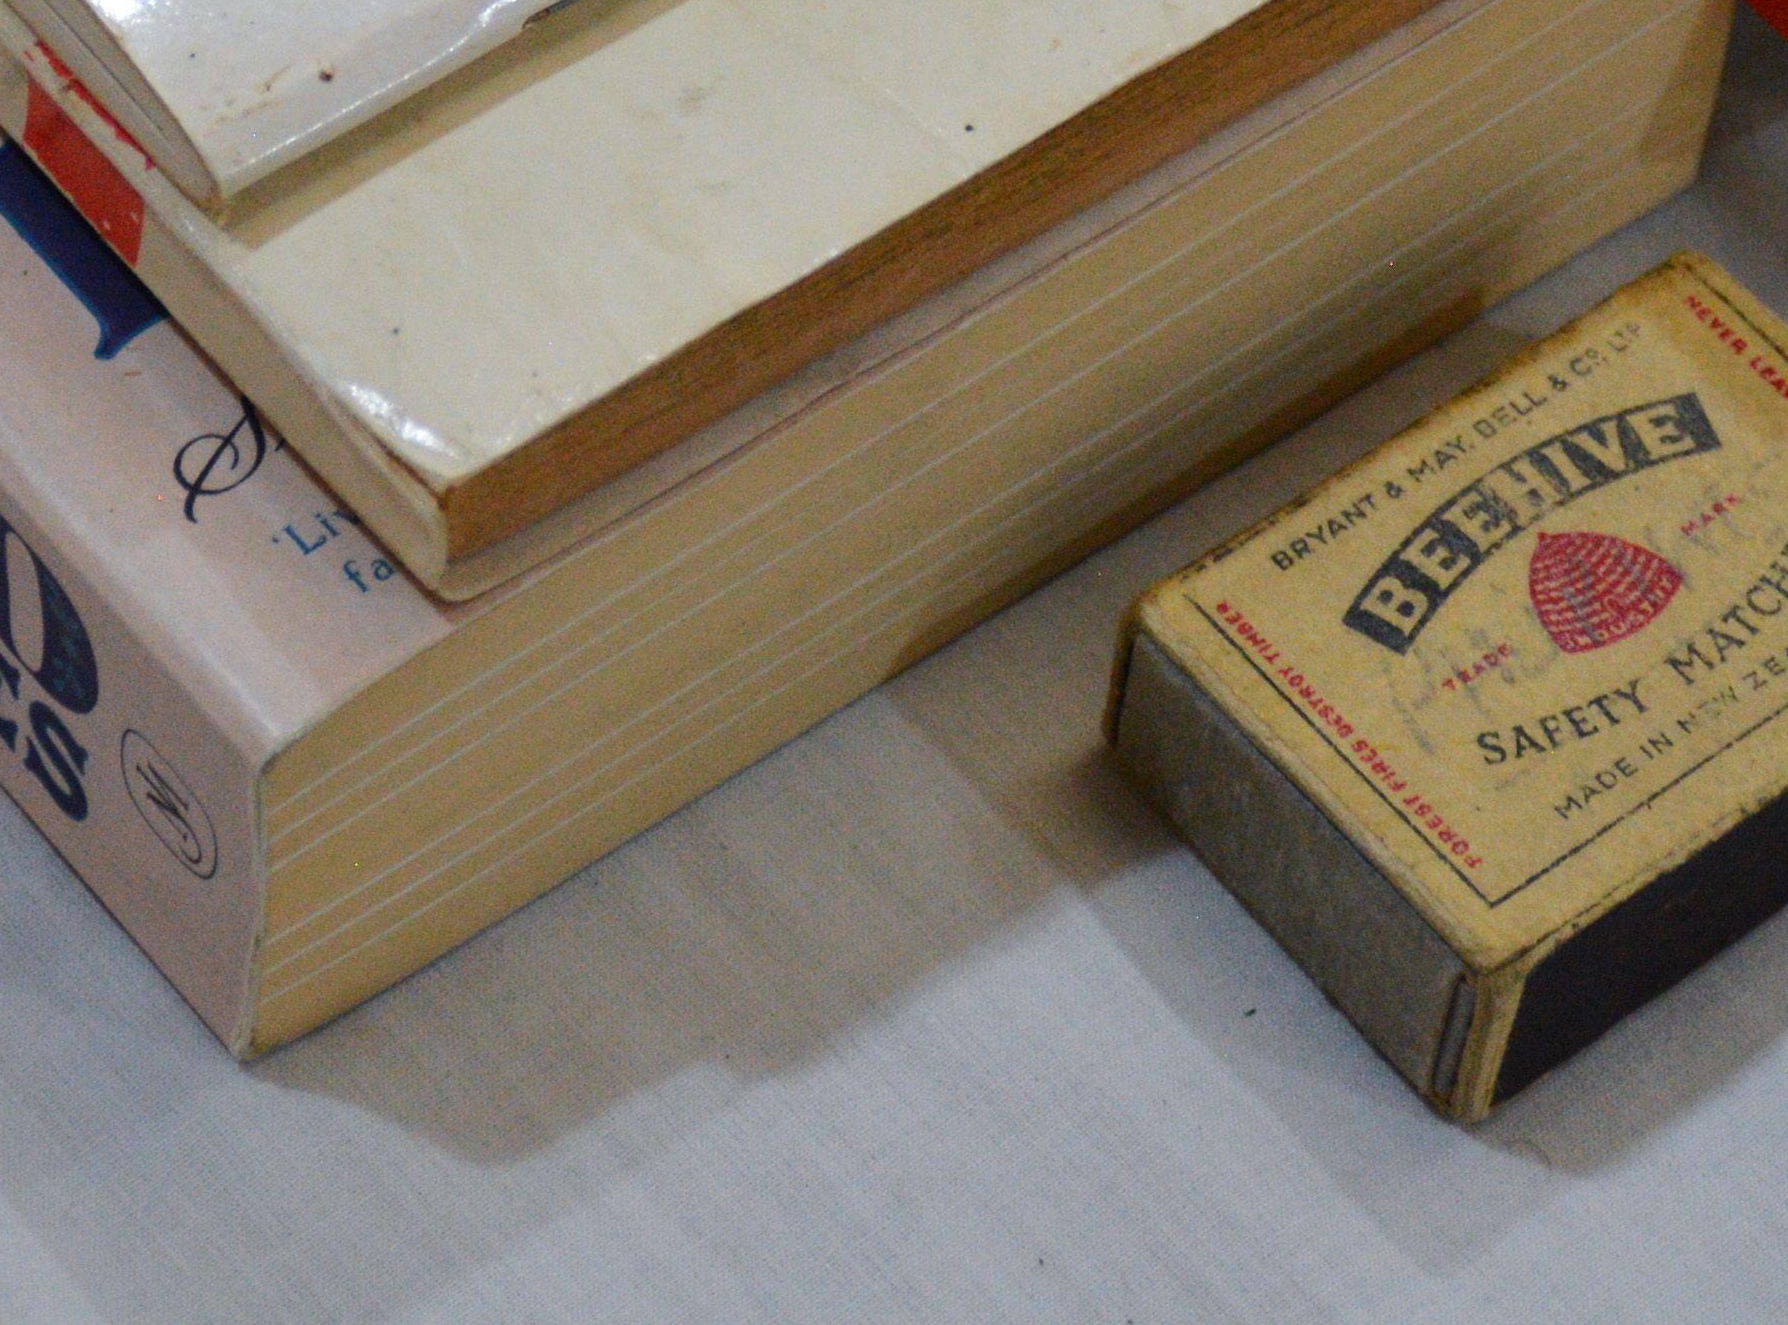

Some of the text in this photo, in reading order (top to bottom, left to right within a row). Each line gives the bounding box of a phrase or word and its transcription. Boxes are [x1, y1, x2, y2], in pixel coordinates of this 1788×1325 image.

[1683, 294, 1749, 356] NEVER
[1270, 493, 1379, 572] BRYANT
[1385, 480, 1406, 500] &
[1547, 372, 1570, 393] &
[1358, 399, 1702, 643] BEEHIVE
[1441, 492, 1743, 692] TRADE MARK
[1215, 600, 1484, 869] FOREST FIRES DESTROY TIMBER
[1475, 678, 1650, 767] SAFETY
[1553, 755, 1639, 821] MADE
[1639, 730, 1675, 762] IN
